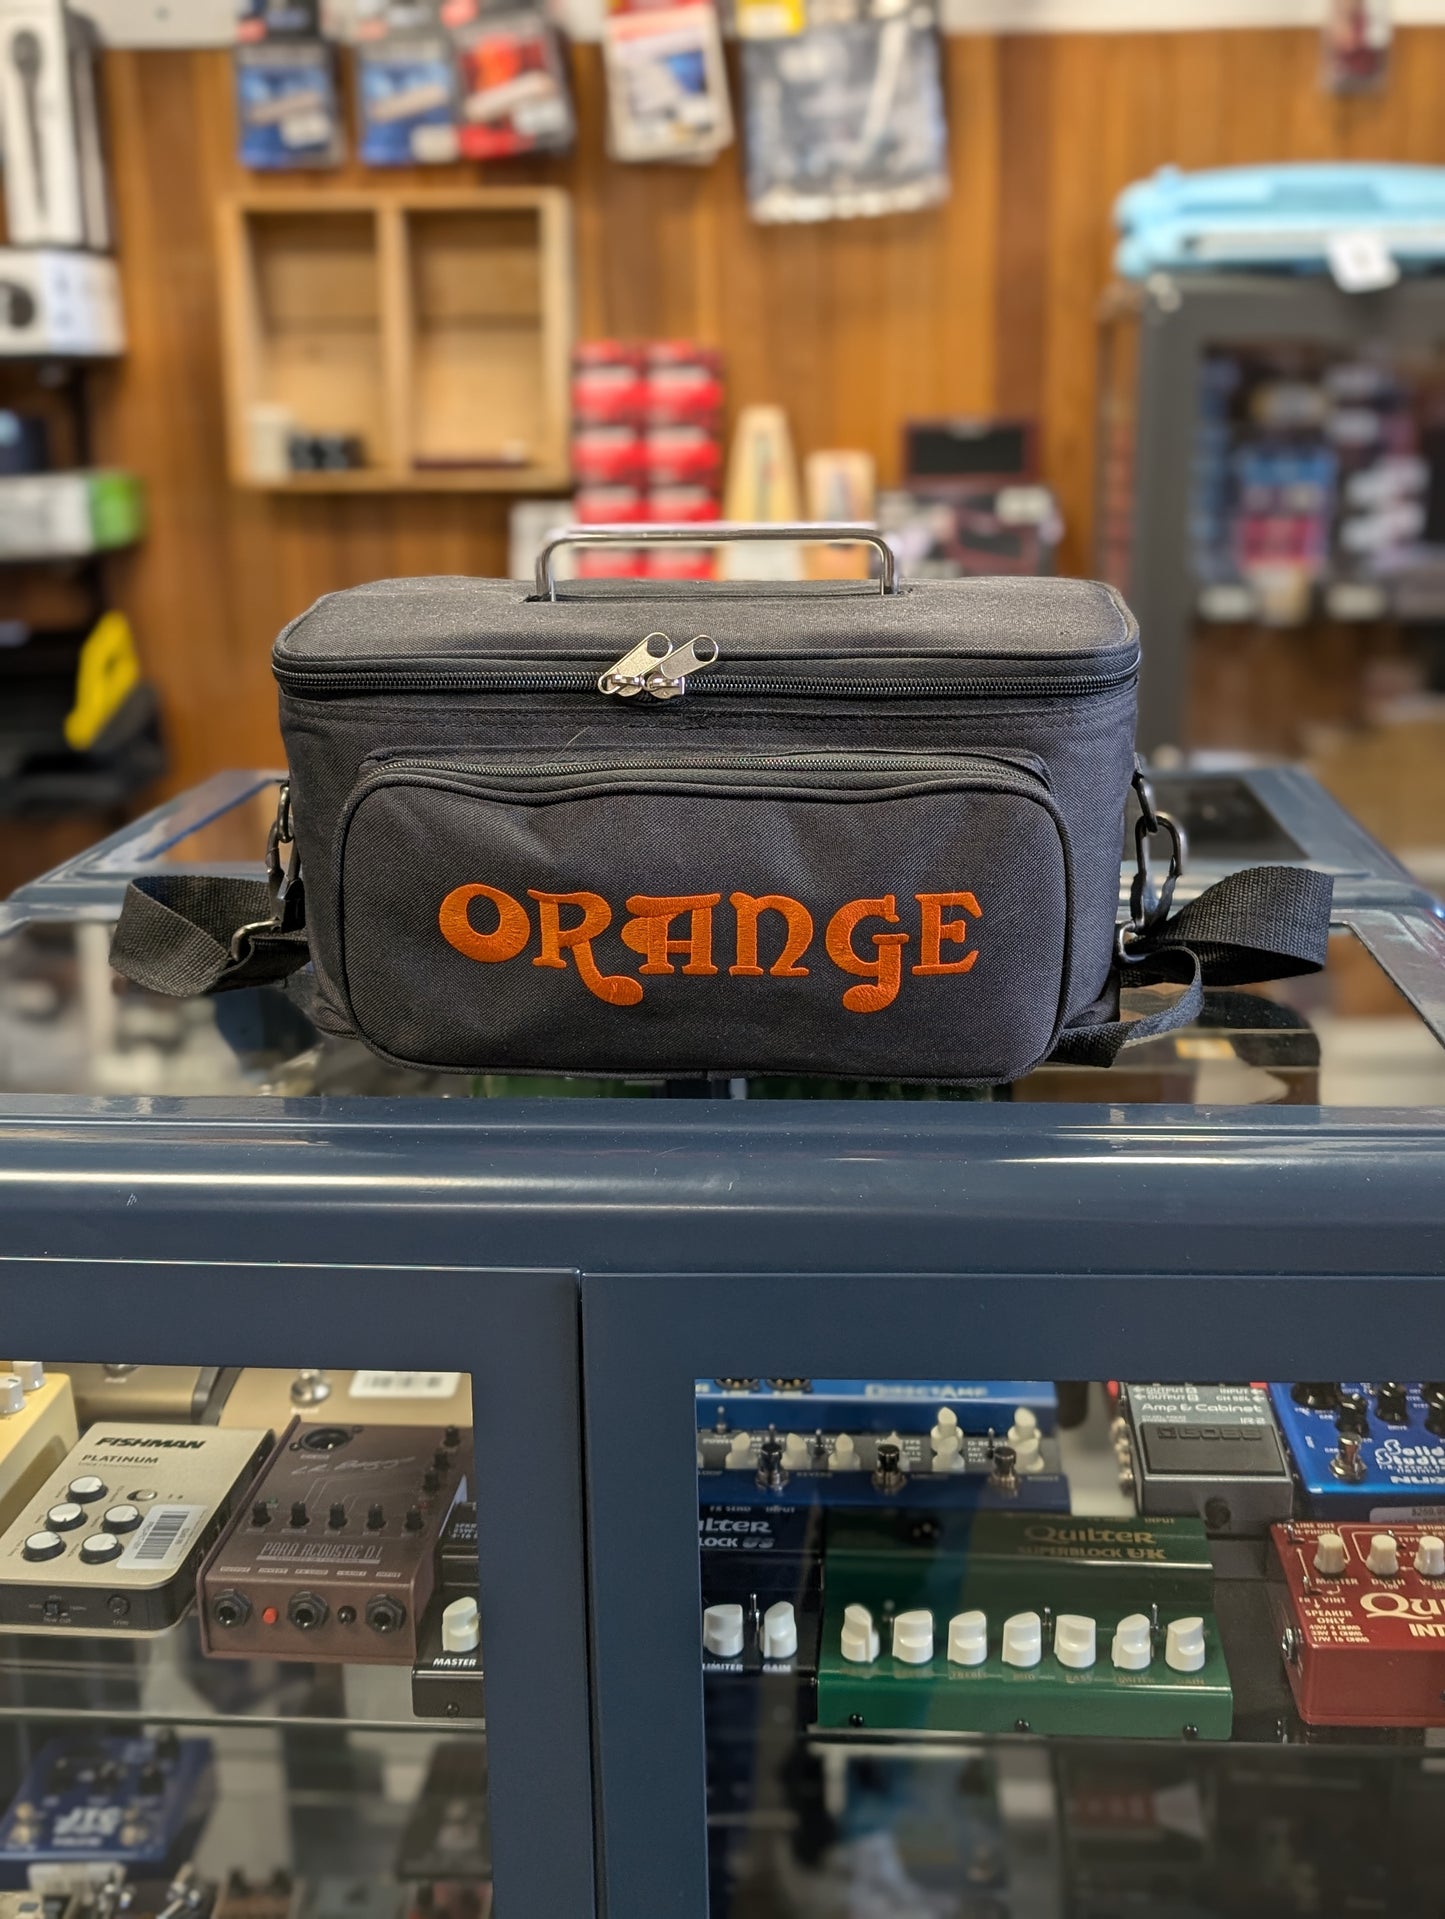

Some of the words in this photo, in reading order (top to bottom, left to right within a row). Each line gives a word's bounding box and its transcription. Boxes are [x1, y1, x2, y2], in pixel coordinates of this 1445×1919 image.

[439, 883, 983, 1013] ORANGE
[1142, 1403, 1177, 1413] Amp
[1179, 1403, 1192, 1411] &
[1195, 1403, 1263, 1413] Cabinet
[95, 1437, 206, 1449] FISHMAN
[1384, 1439, 1445, 1456] Solid
[81, 1454, 159, 1464] PLATINUM
[765, 1505, 796, 1513] INPUT
[1144, 1516, 1176, 1524] INPUT
[1024, 1525, 1157, 1544] Quilter
[260, 1542, 299, 1556] PARA
[300, 1544, 363, 1558] ACOUSTIC
[1126, 1548, 1168, 1560] UK
[1304, 1609, 1353, 1618] SPEAKER
[1316, 1617, 1345, 1625] ONLY
[433, 1658, 477, 1667] MASTER
[702, 1663, 744, 1673] LIMITER
[762, 1664, 792, 1672] GAIN
